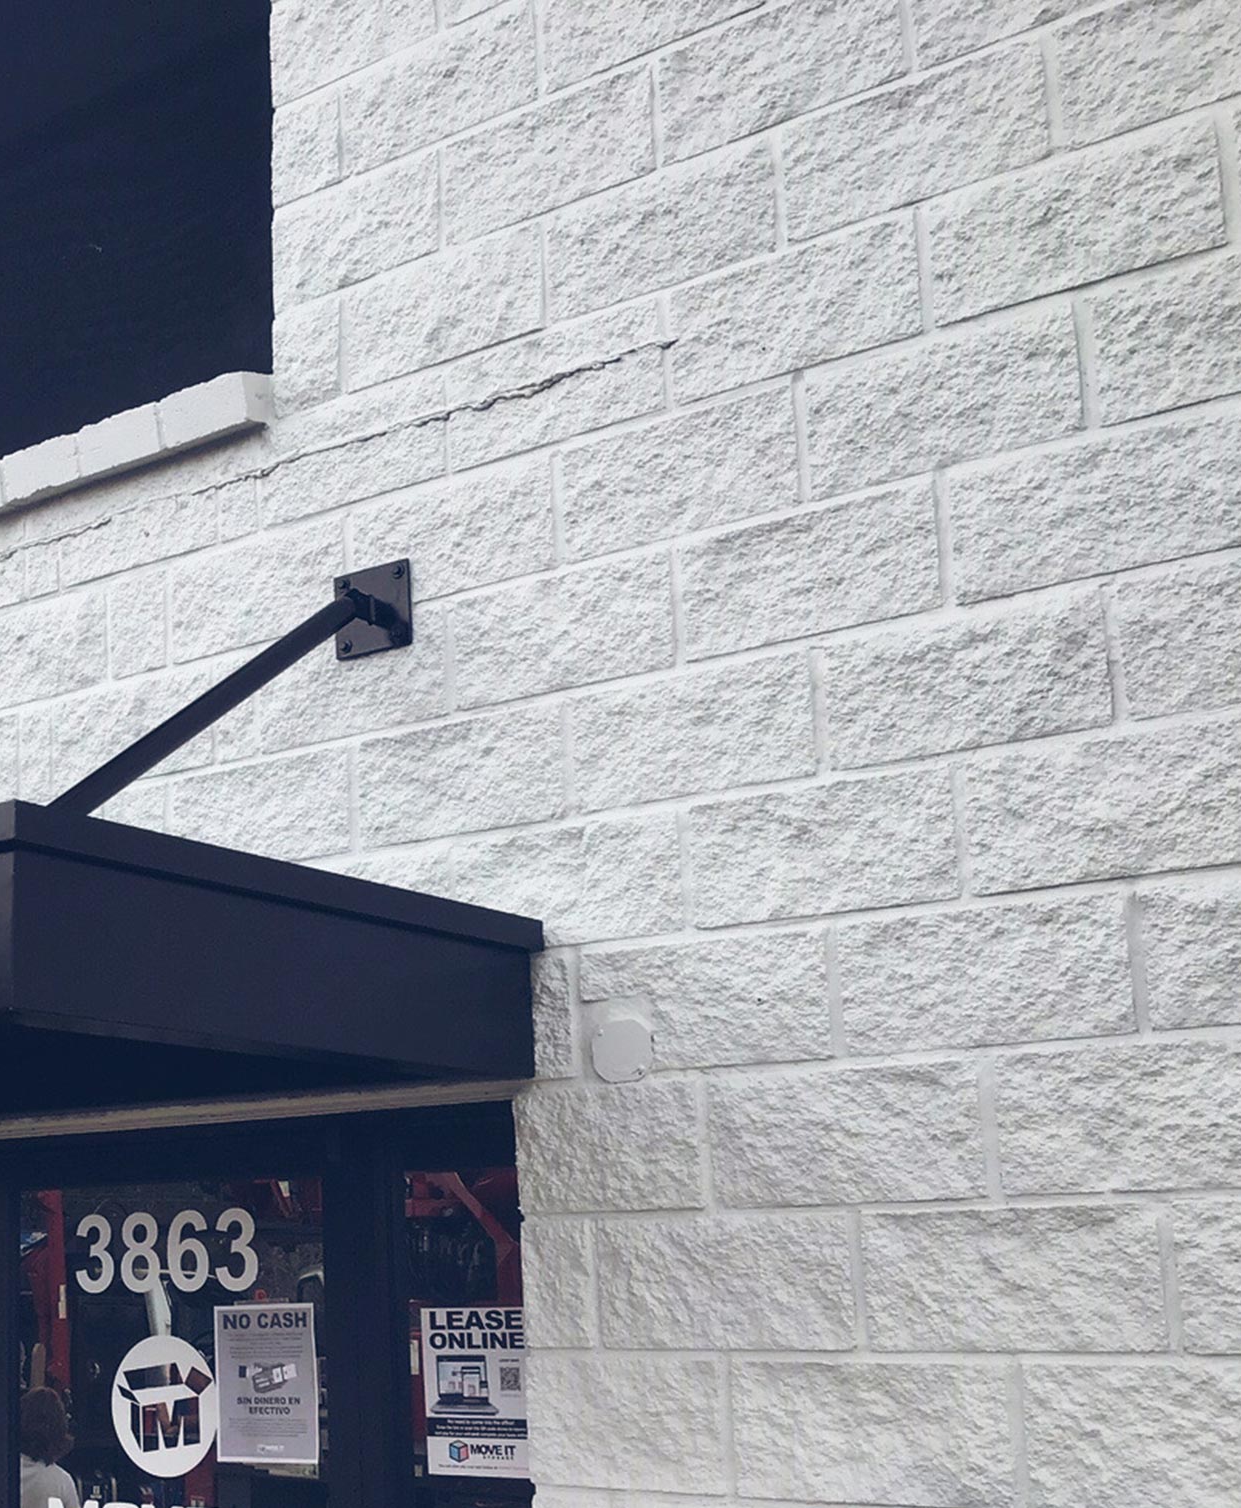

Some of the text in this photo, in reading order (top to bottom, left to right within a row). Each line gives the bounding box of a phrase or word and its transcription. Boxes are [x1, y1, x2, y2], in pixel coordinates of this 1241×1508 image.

[75, 1207, 258, 1294] 3863
[223, 1312, 307, 1330] NO CASH
[429, 1310, 523, 1331] LEASE
[429, 1332, 525, 1350] ONLINE
[237, 1397, 300, 1405] SIN DINERO EN
[249, 1406, 291, 1415] EFECTIVO
[470, 1444, 516, 1455] MOVE IT
